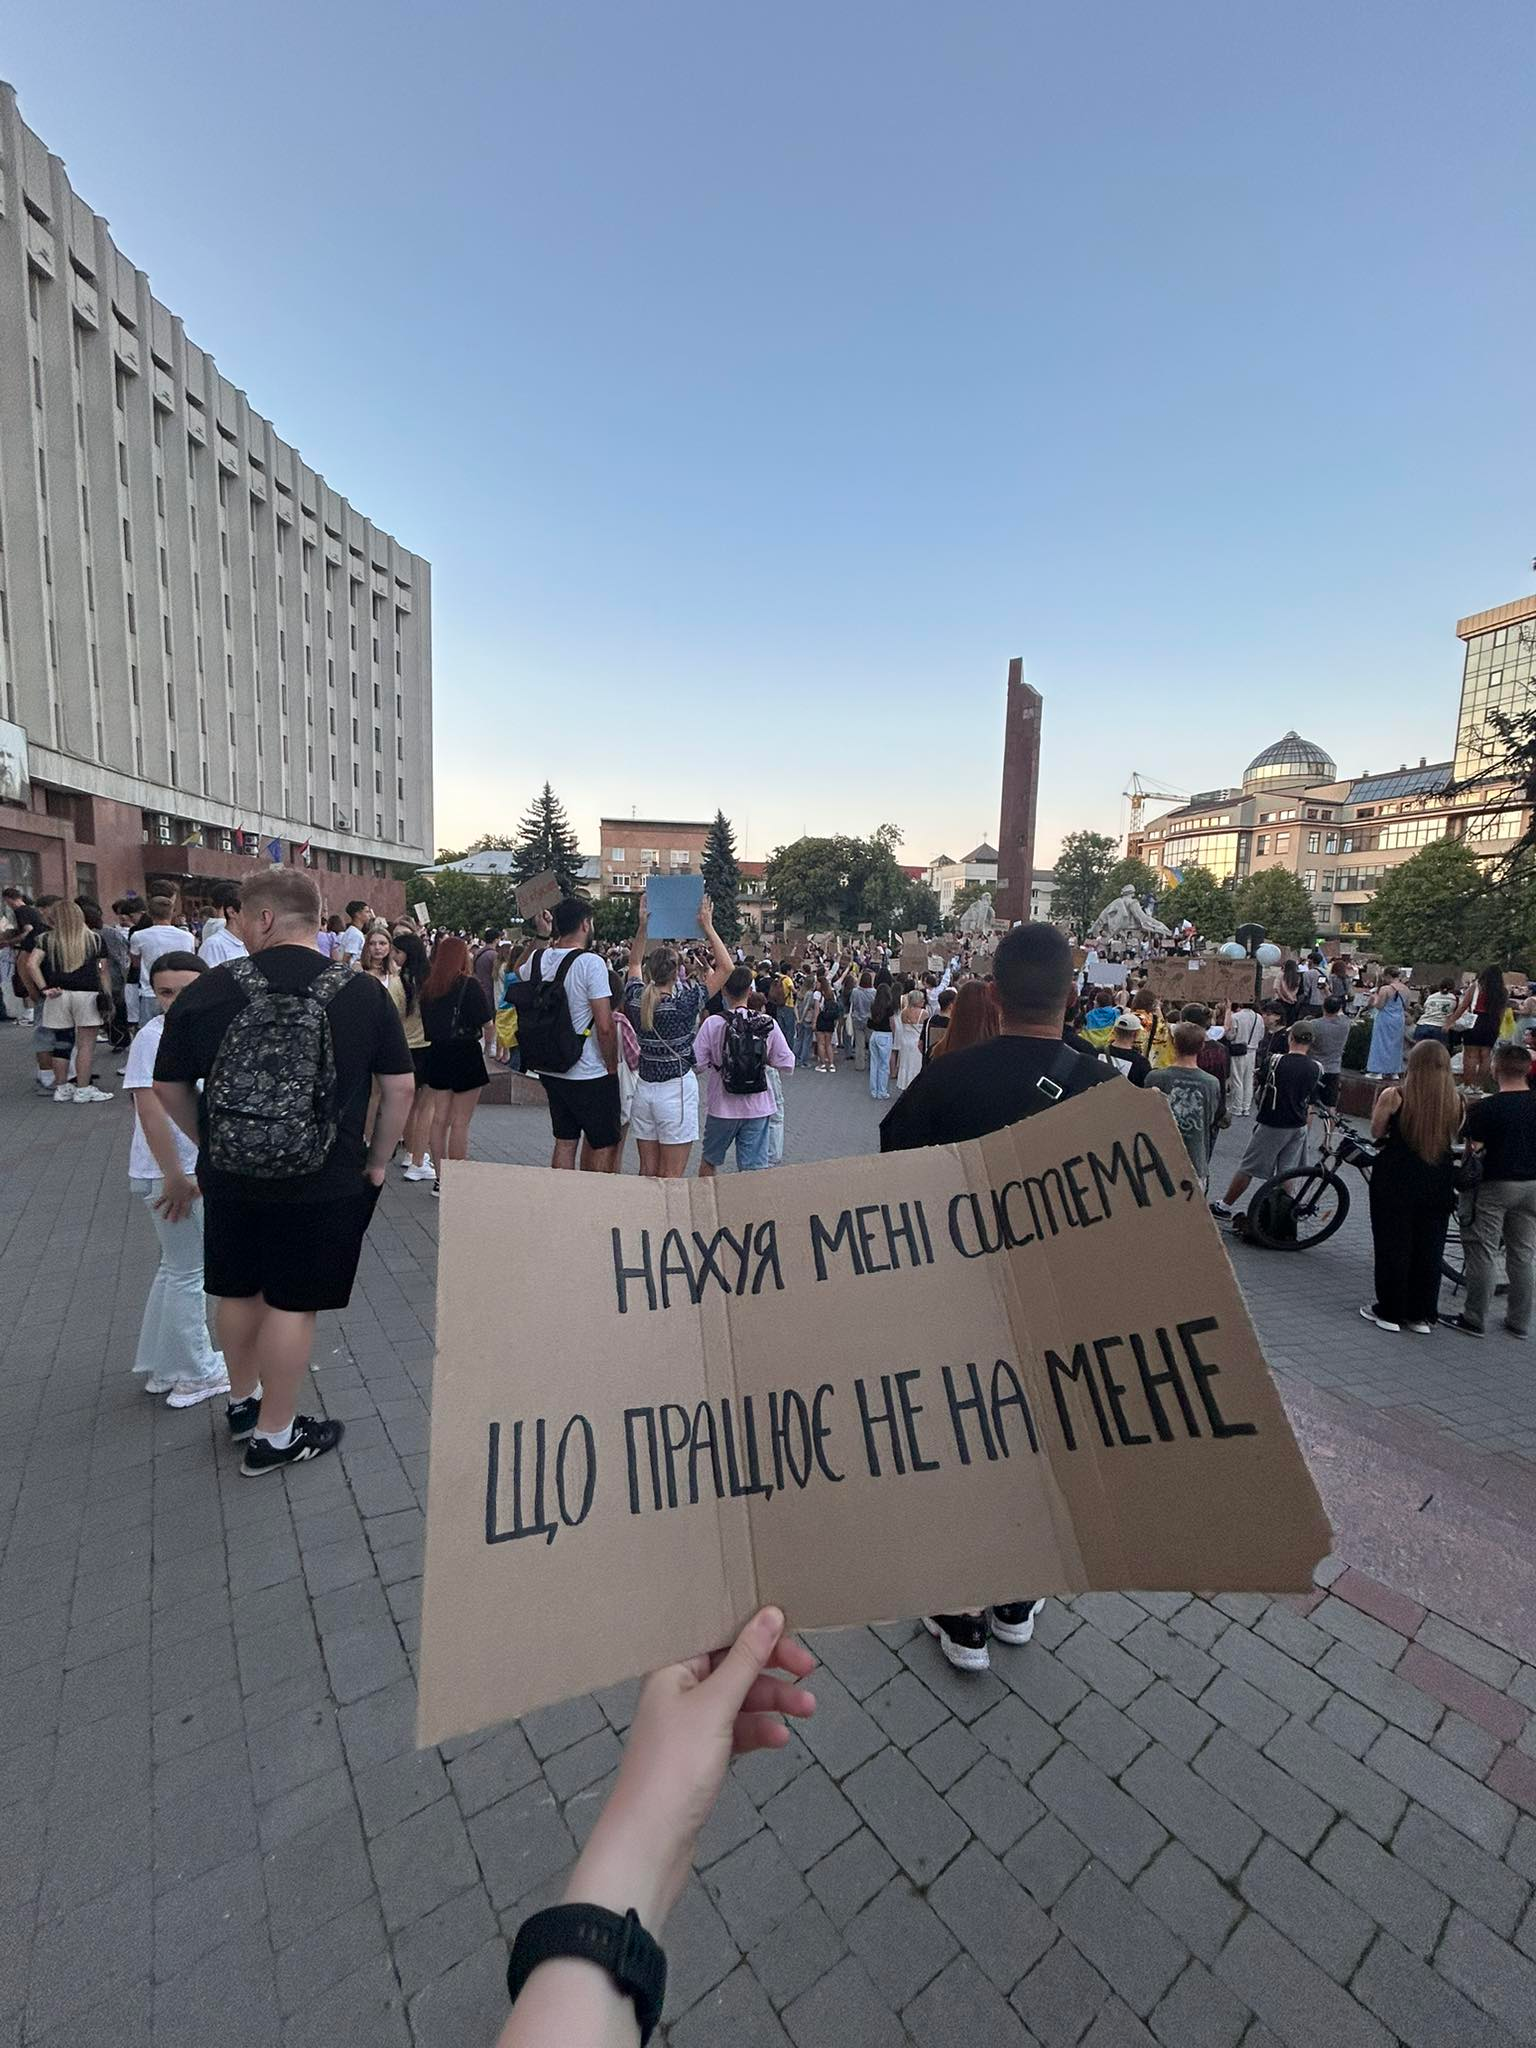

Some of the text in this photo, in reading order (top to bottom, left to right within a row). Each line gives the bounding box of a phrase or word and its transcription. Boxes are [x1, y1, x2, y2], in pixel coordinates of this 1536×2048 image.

[610, 1219, 786, 1314] НАХУЯ
[809, 1200, 936, 1281] МЕНІ
[485, 1315, 1258, 1545] ЩО ПРАЦЮЄ НЕ НА МЕНЕ
